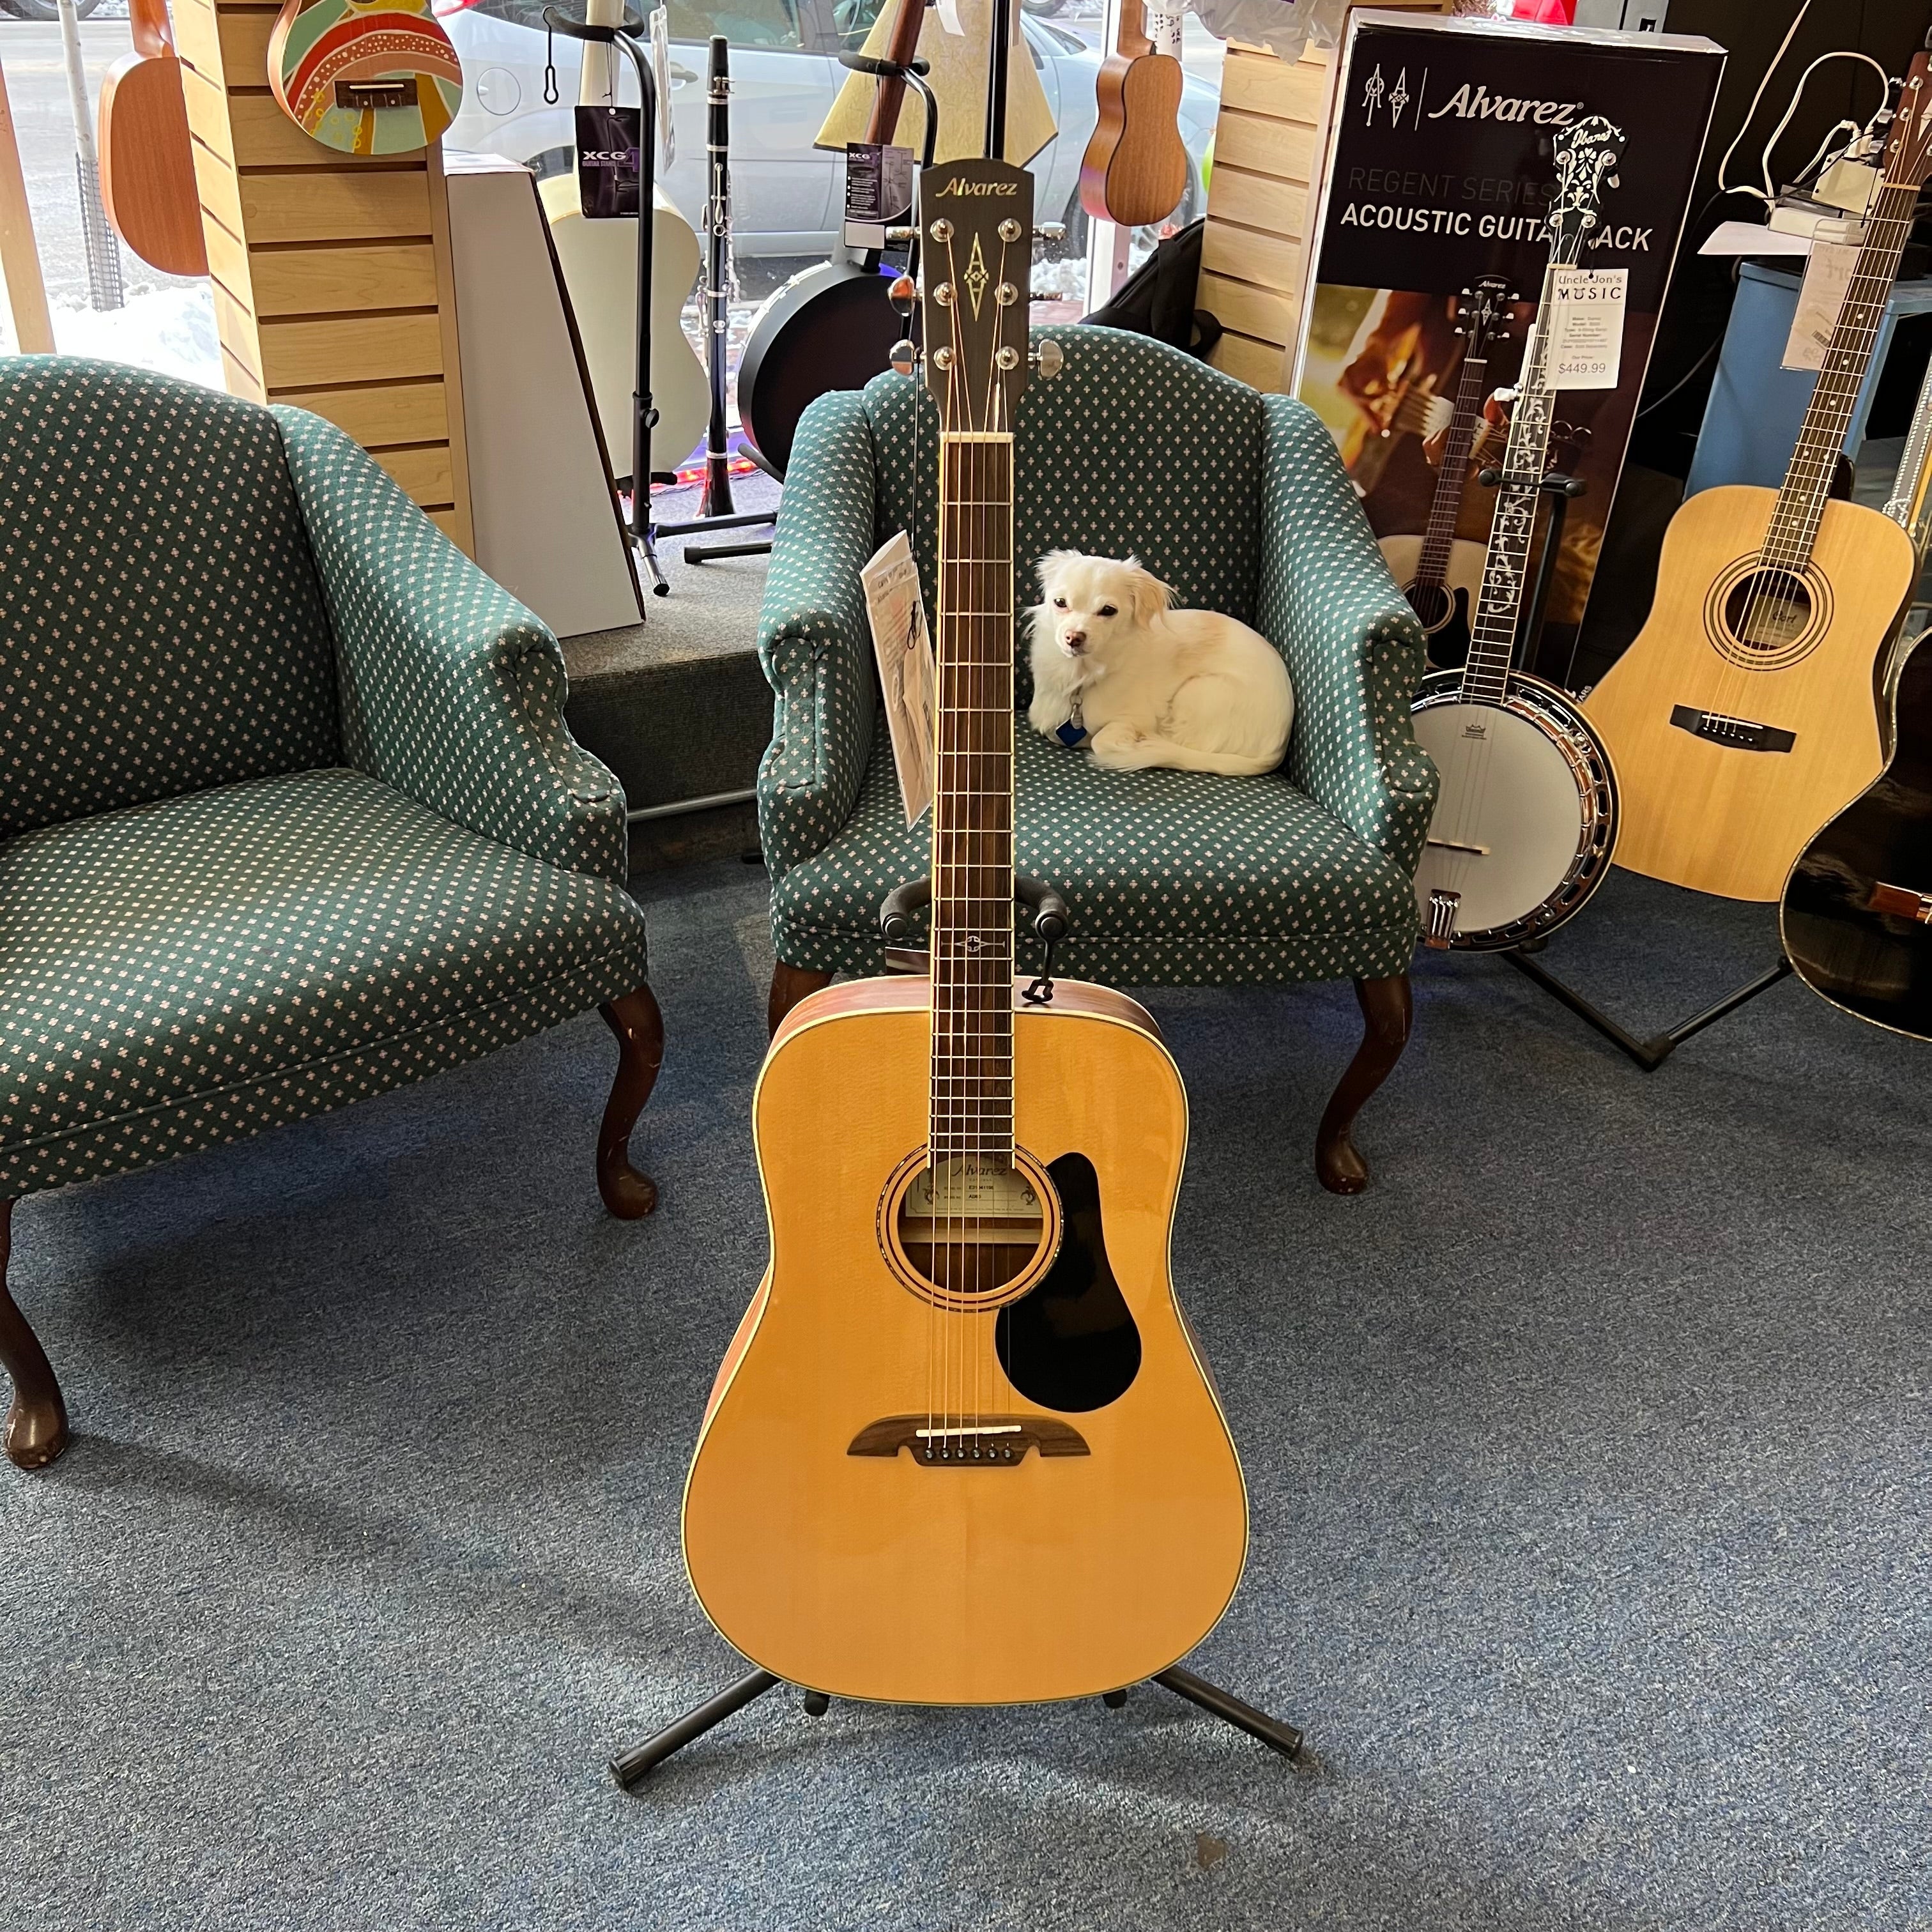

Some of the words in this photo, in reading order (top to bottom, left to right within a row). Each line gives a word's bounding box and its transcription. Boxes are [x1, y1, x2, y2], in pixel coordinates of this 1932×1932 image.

[935, 177, 1018, 197] Alvarez
[1349, 167, 1456, 199] REGENT
[1462, 178, 1556, 208] SERIES
[1340, 203, 1471, 236] ACOUSTIC
[1478, 215, 1554, 243] GUITA
[1595, 225, 1653, 252] ACK
[1558, 275, 1588, 284] Uncle
[1591, 275, 1622, 284] Jon's
[1558, 287, 1621, 300] MUSIC
[1558, 363, 1606, 374] $449.99
[951, 1163, 1008, 1177] Alvarez
